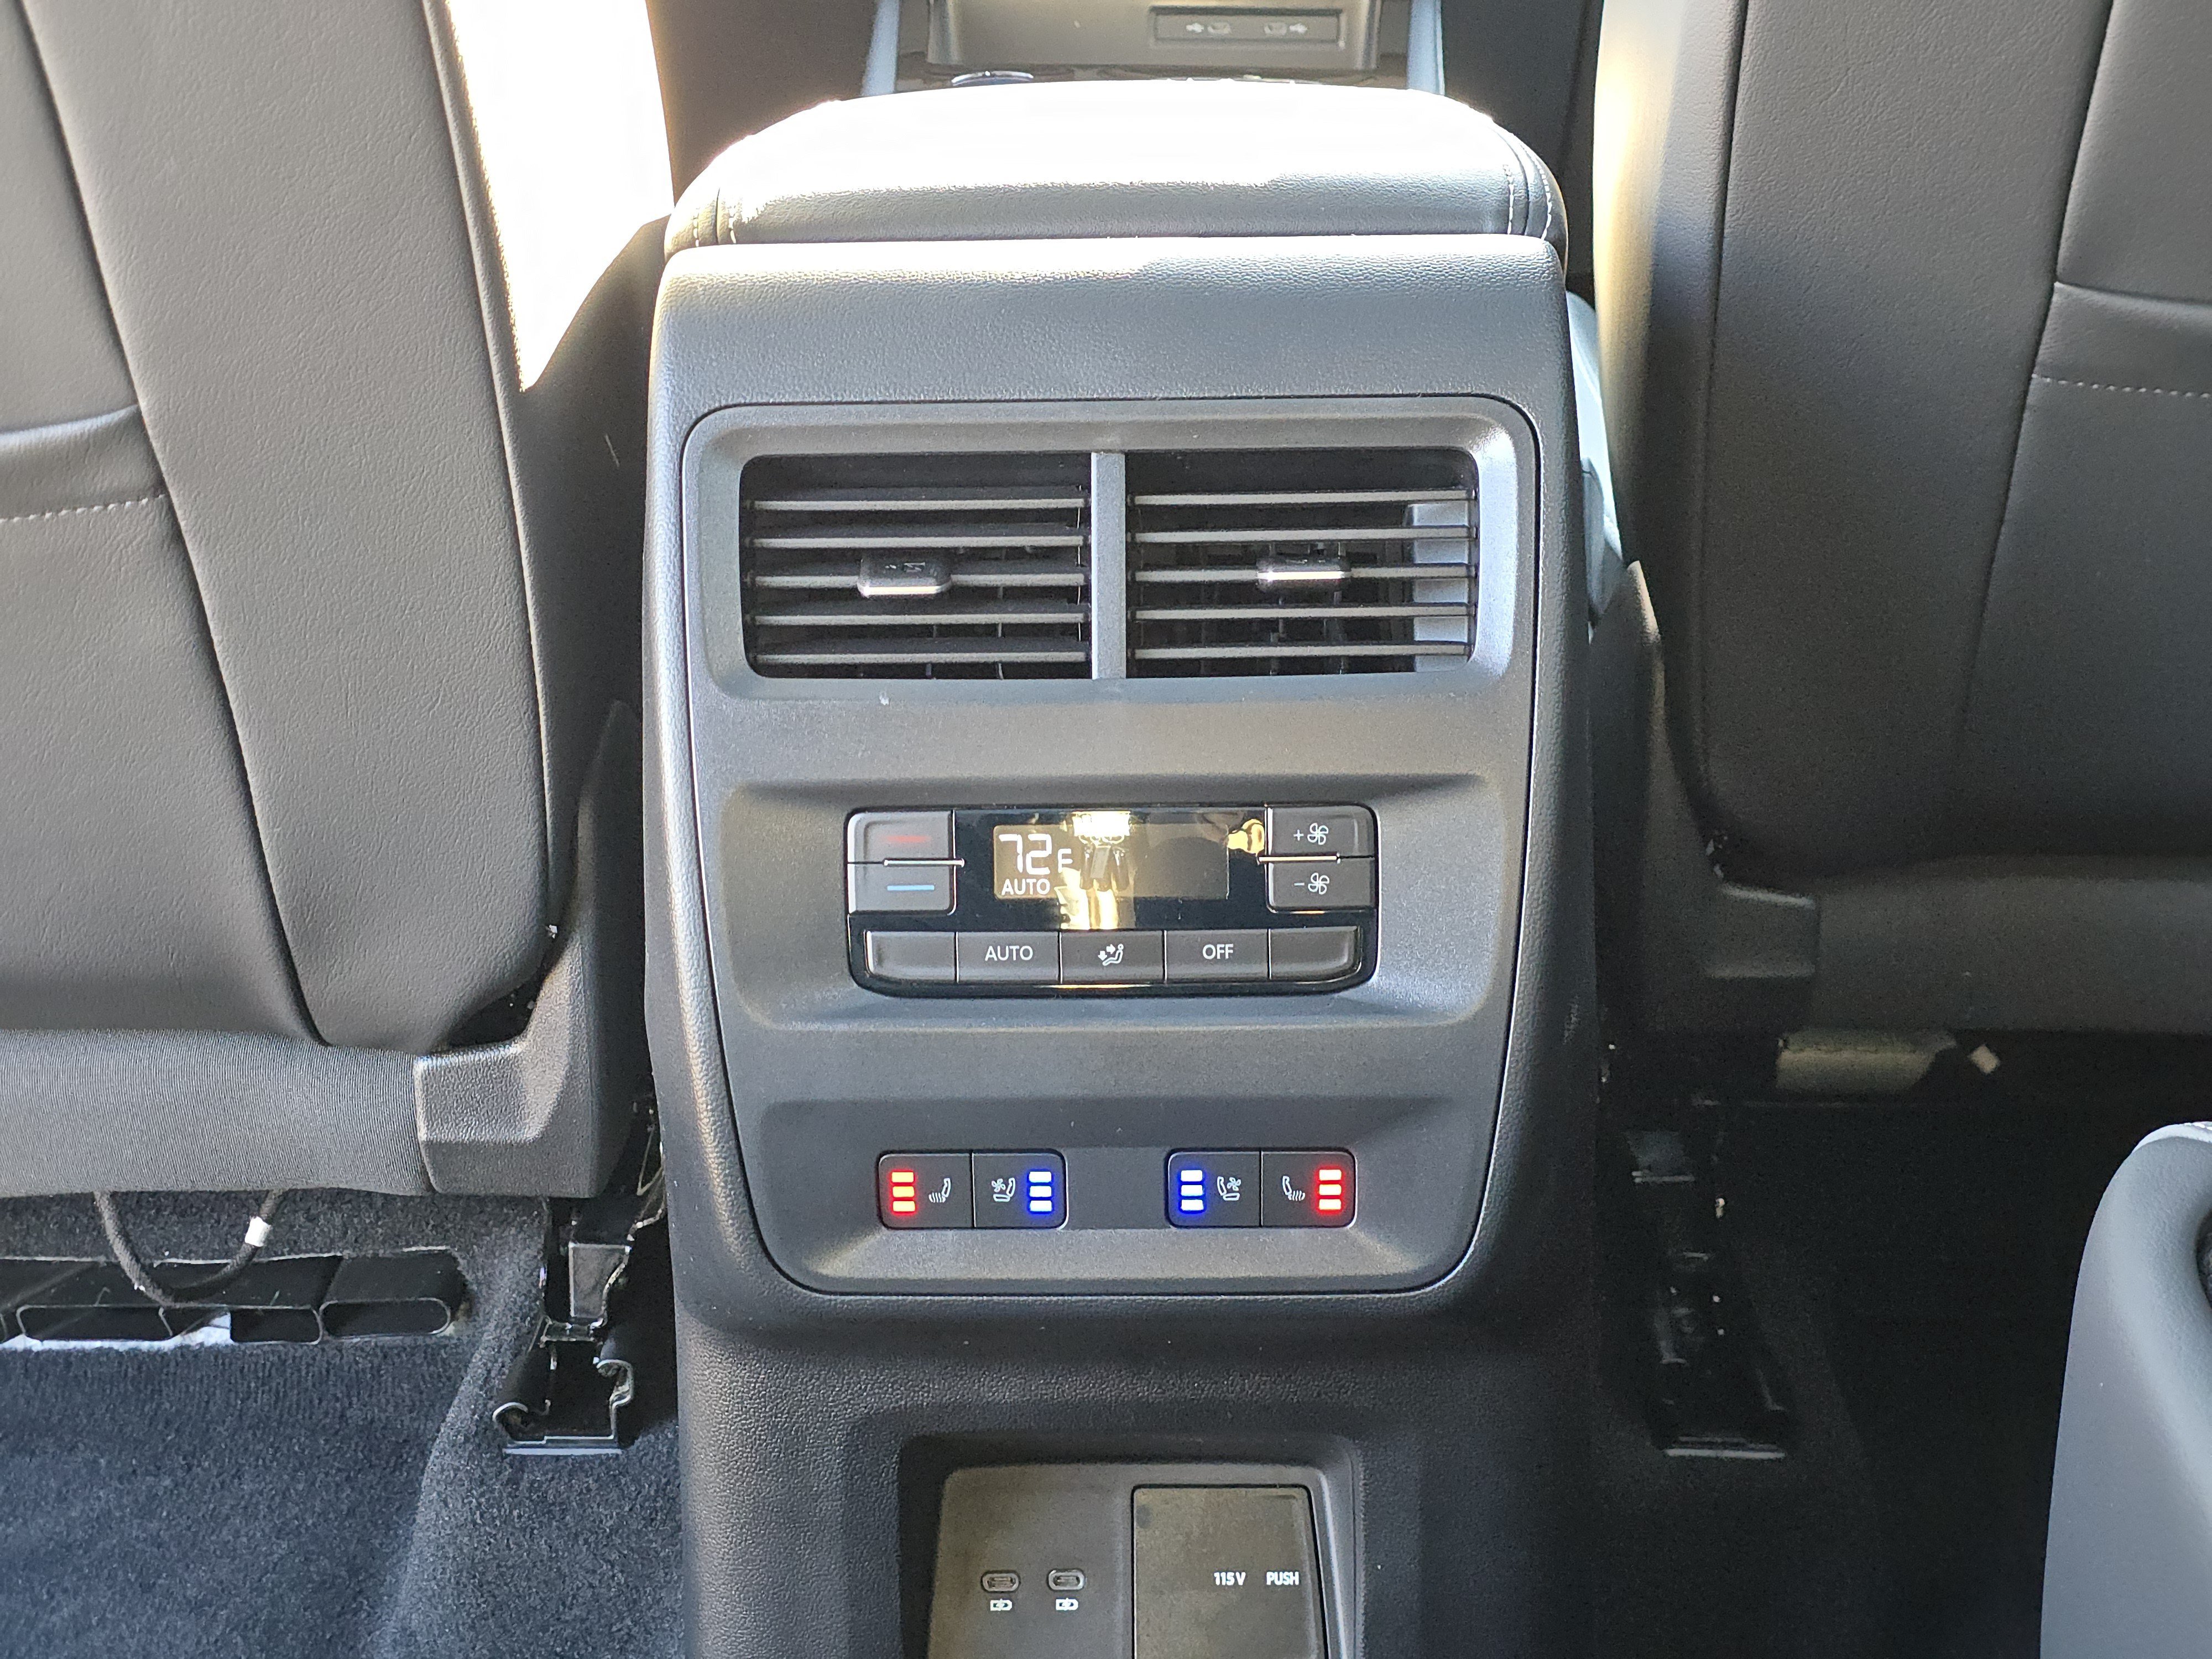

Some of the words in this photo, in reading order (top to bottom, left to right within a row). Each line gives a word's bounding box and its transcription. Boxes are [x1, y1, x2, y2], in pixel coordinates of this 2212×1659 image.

[1001, 878, 1051, 895] AUTO
[984, 945, 1034, 961] AUTO
[1202, 943, 1234, 959] OFF
[1214, 1571, 1246, 1586] 115V
[1266, 1571, 1300, 1585] PUSH
